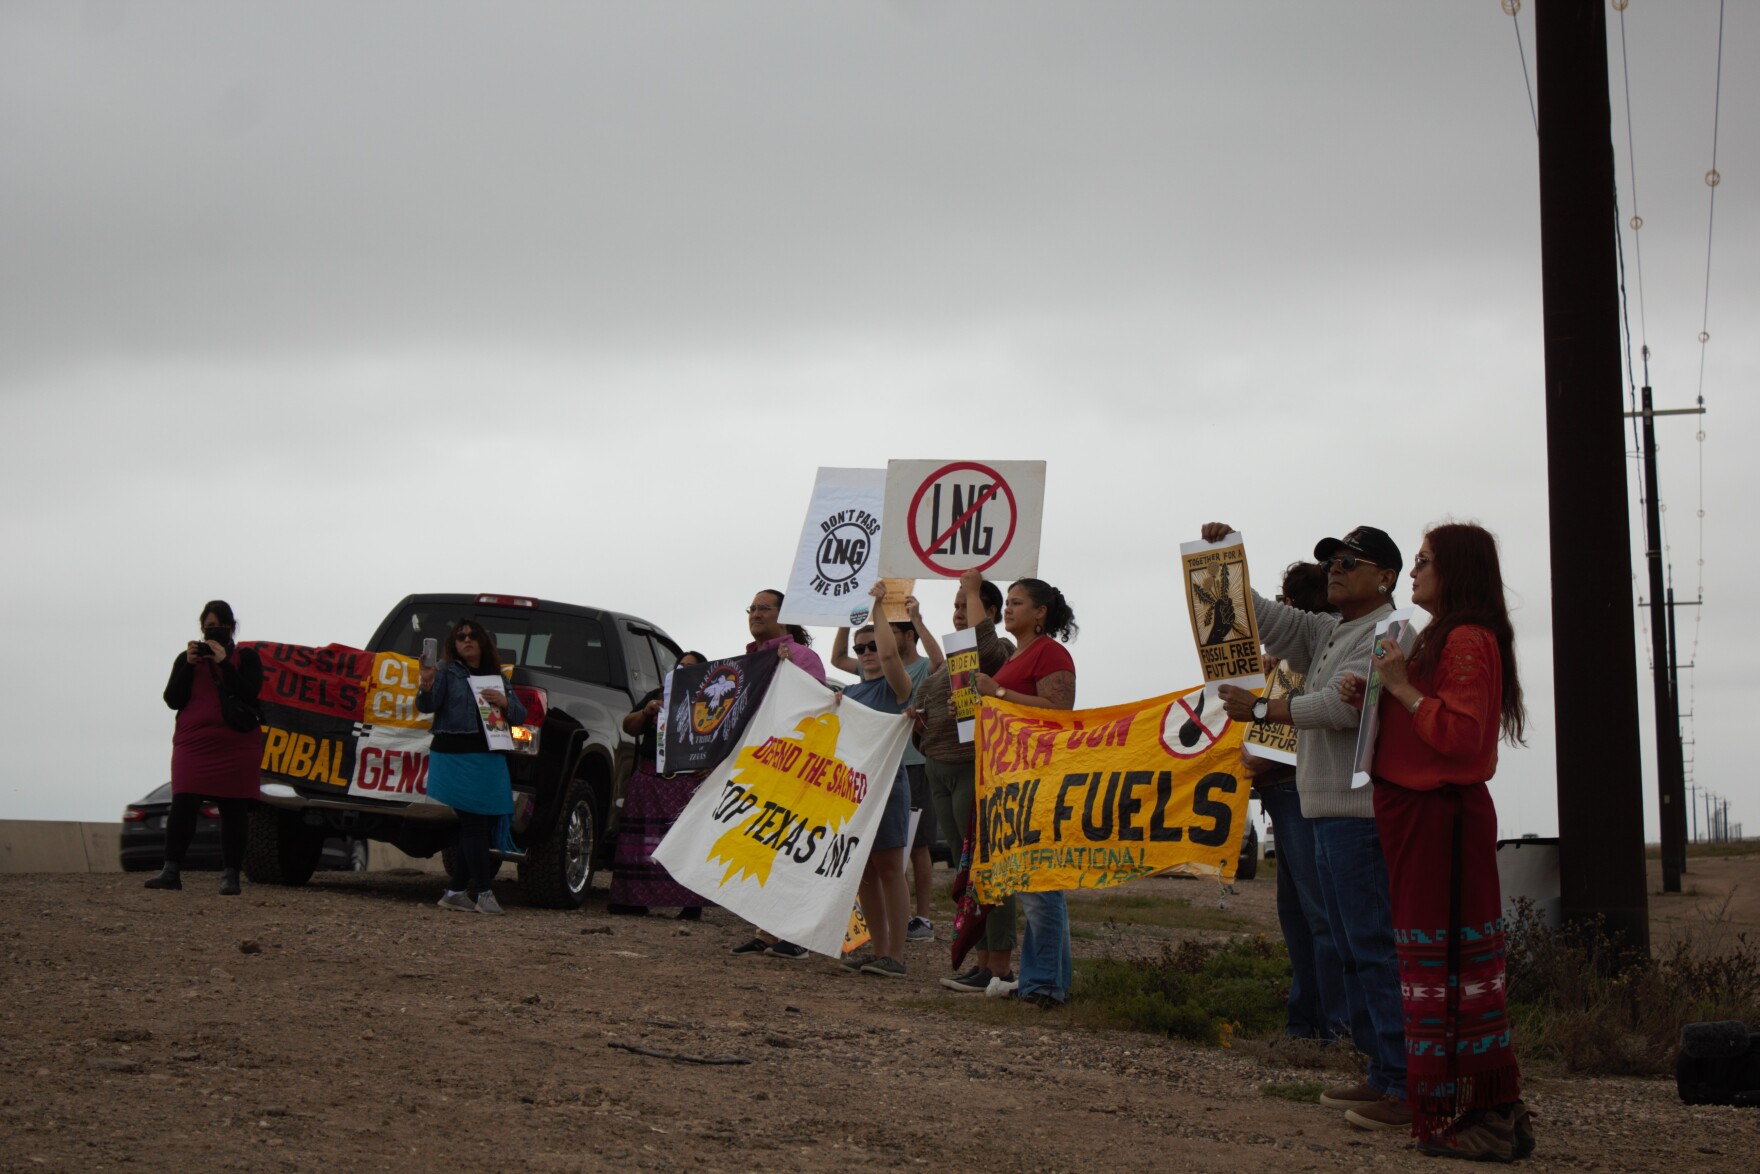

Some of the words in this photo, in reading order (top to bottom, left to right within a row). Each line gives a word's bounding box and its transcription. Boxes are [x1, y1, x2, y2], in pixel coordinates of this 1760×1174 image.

[821, 510, 855, 533] DON'T
[855, 511, 880, 535] PASS
[930, 483, 997, 556] LNG
[821, 538, 866, 565] LNG
[1188, 552, 1220, 567] TOGETHER
[1223, 551, 1236, 560] FOR
[1238, 549, 1242, 558] A
[810, 574, 831, 596] THE
[834, 577, 859, 596] GAS
[951, 653, 977, 672] BIDEN
[1201, 646, 1229, 664] FOSSIL
[1230, 641, 1256, 659] FREE
[1205, 658, 1260, 679] FUTURE
[1248, 729, 1298, 752] FUTUR
[752, 736, 802, 773] DEFEND
[797, 752, 833, 787] THE
[827, 763, 868, 804] SACRED
[1053, 771, 1238, 847] FUELS
[712, 780, 758, 823] TOP
[744, 801, 827, 863] TEXAS
